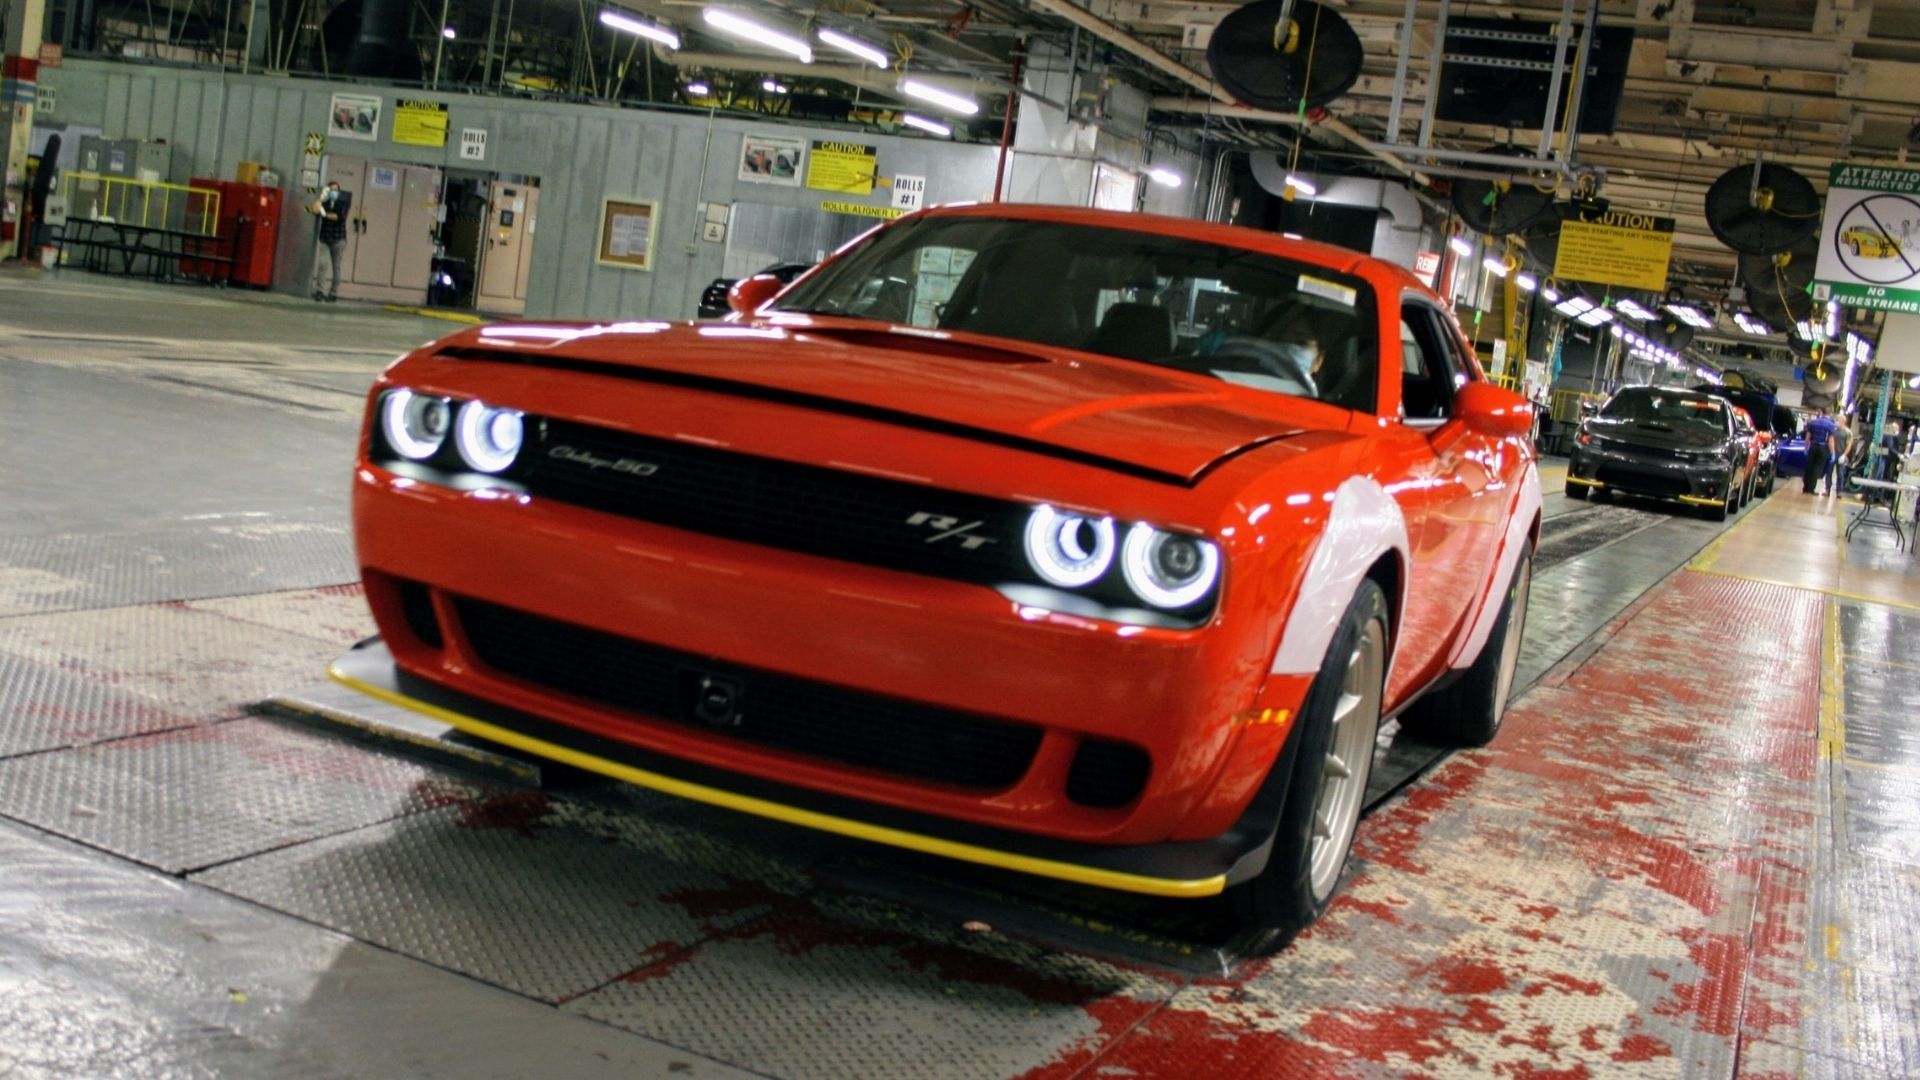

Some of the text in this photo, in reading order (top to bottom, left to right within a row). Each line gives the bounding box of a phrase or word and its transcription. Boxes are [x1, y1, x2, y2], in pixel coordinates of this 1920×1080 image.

[403, 98, 440, 112] CAUTION
[464, 132, 485, 144] ROLLS
[821, 142, 865, 155] CAUTION
[895, 178, 923, 192] ROLLS
[1835, 177, 1914, 191] RESTRICTED
[900, 194, 915, 206] #1
[1867, 286, 1885, 296] NO
[1832, 294, 1917, 312] PEDESTRIANS
[905, 511, 998, 549] R/T
